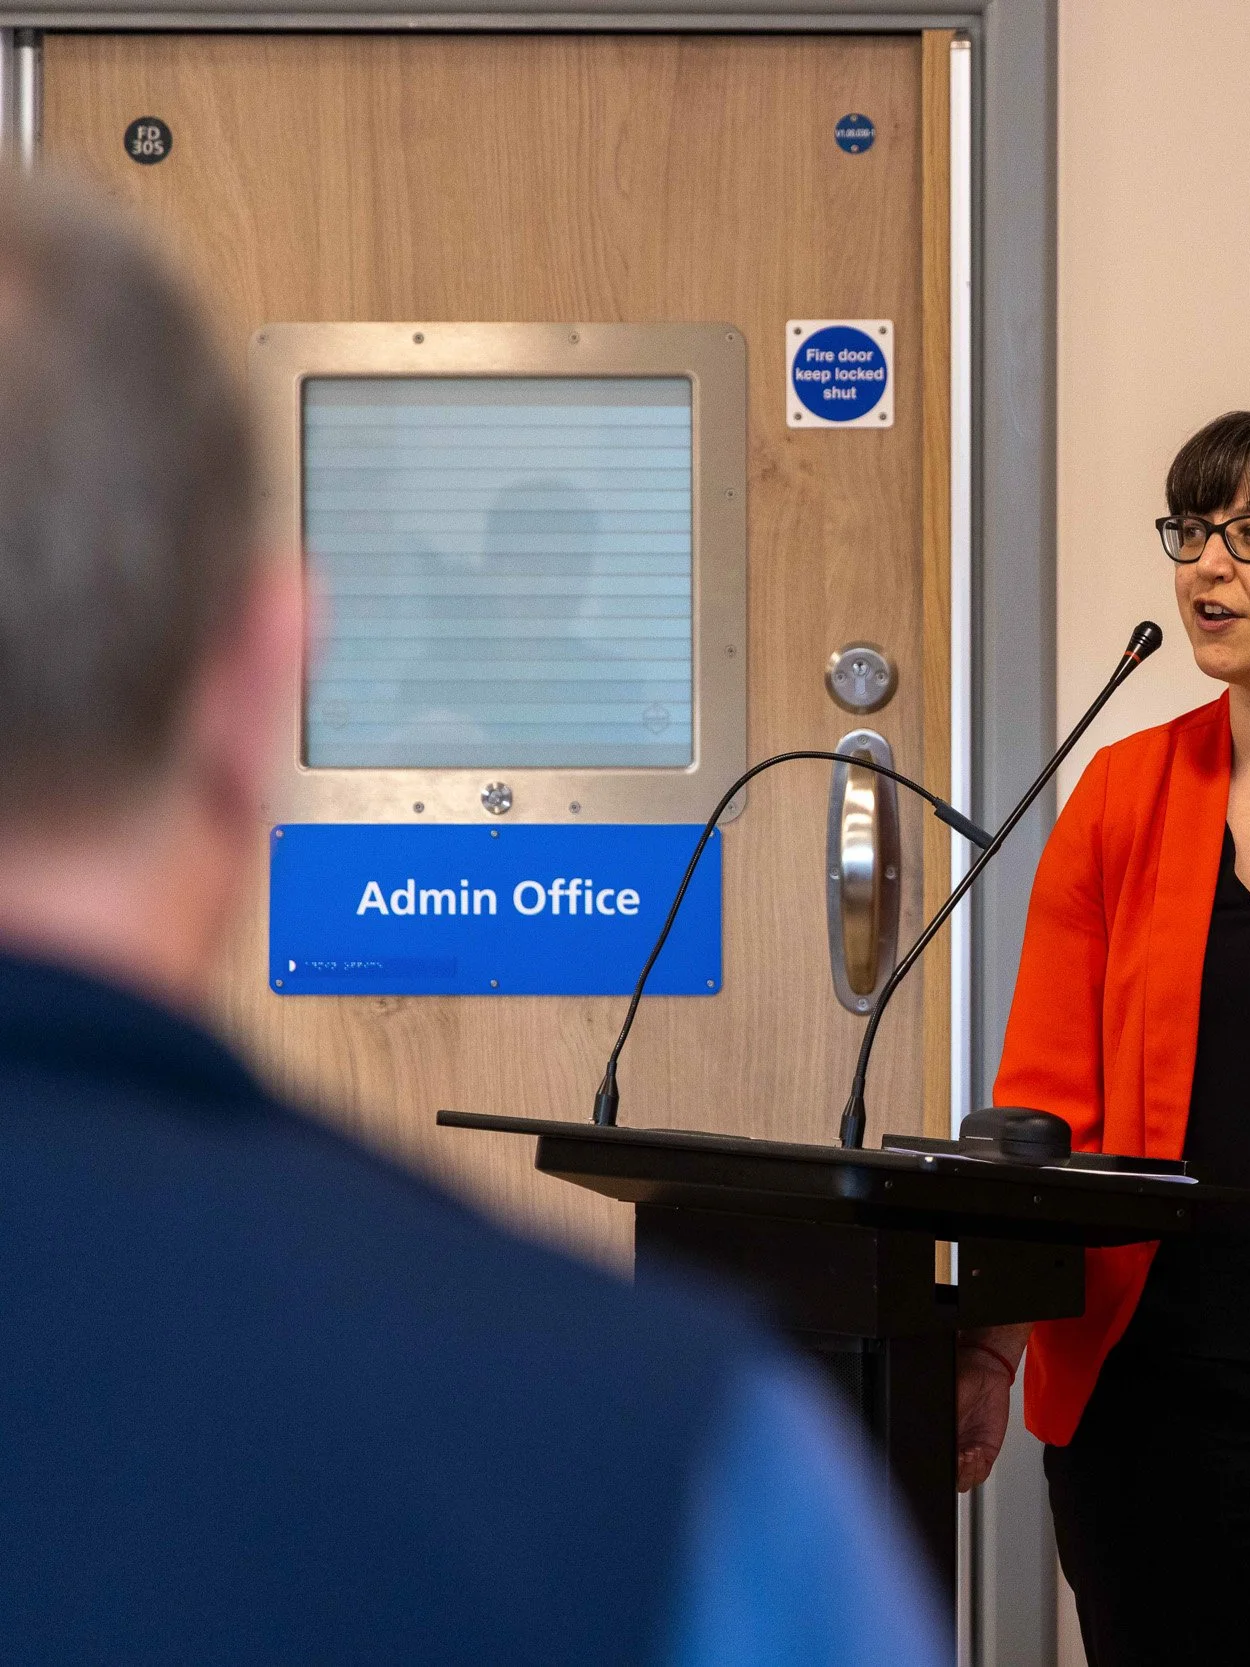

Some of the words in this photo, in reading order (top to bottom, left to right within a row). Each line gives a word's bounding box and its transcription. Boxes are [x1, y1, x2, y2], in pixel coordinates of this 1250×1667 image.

[137, 125, 161, 140] FD
[131, 140, 164, 155] 30S
[806, 348, 835, 362] Fire
[838, 348, 873, 362] door
[795, 367, 832, 384] keep
[835, 367, 885, 381] locked
[823, 386, 857, 400] shut
[356, 878, 498, 915] Admin
[512, 878, 641, 915] Office
